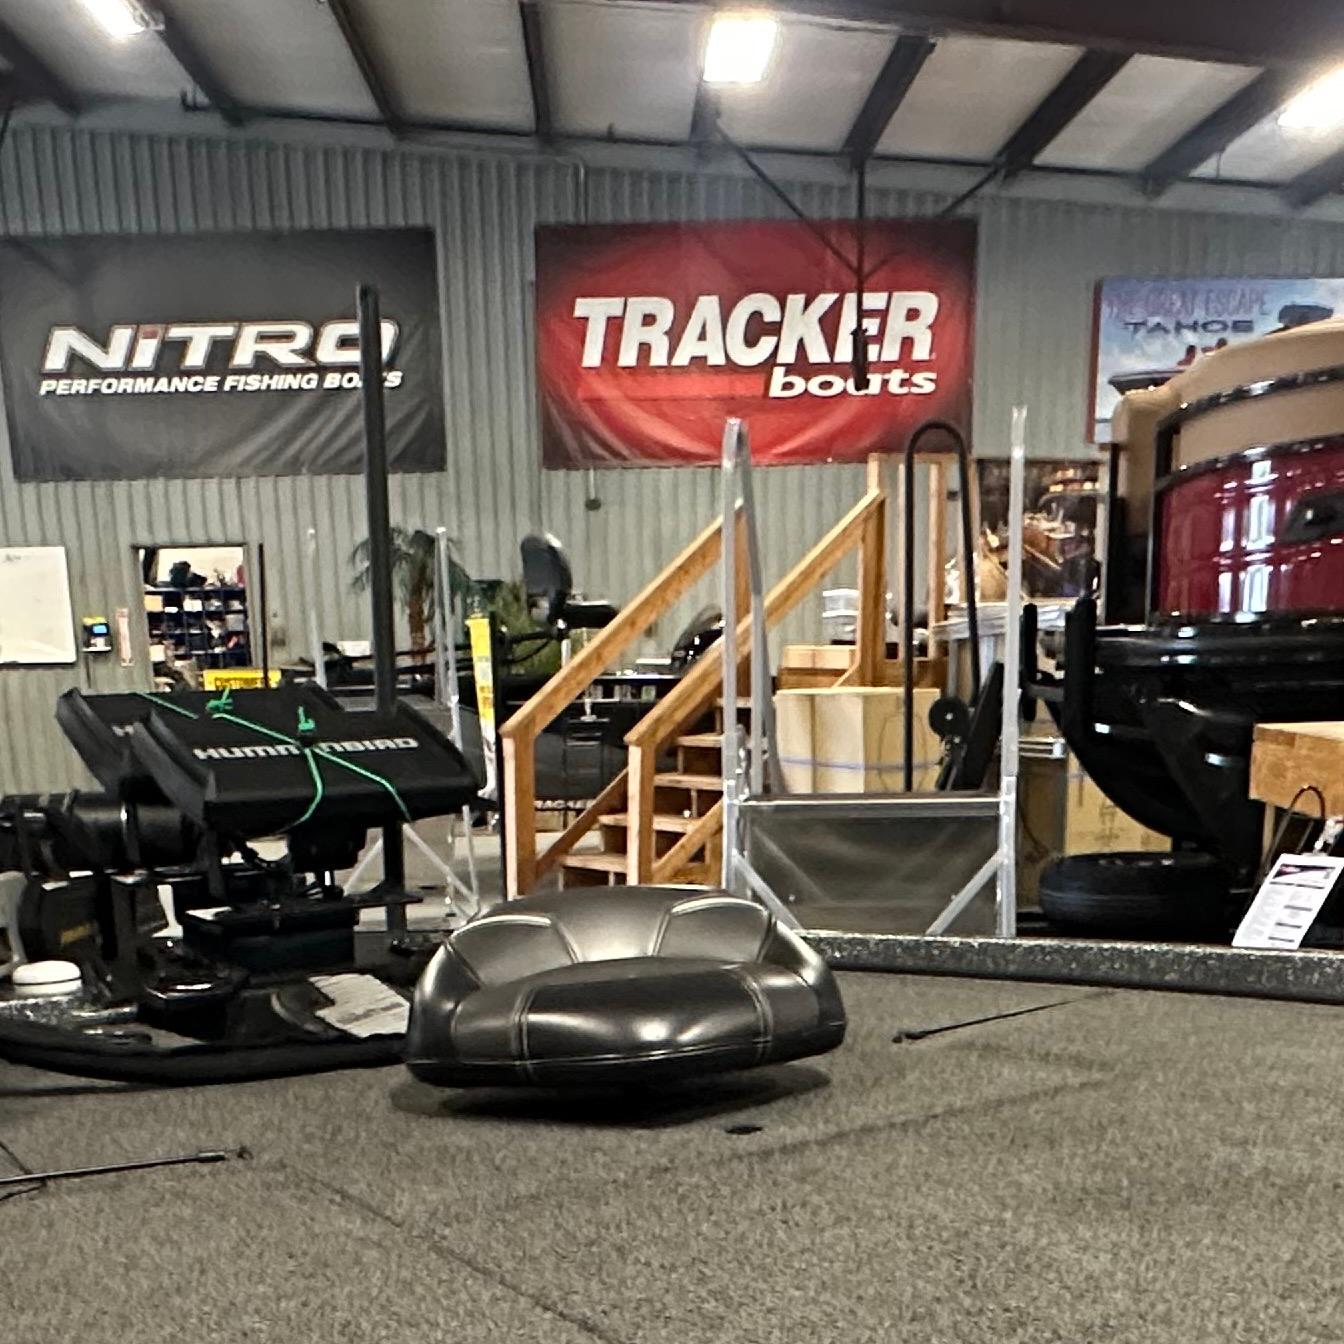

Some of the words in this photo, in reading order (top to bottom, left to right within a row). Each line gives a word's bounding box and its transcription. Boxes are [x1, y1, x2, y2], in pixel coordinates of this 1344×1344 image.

[41, 319, 400, 374] NITRO
[573, 291, 939, 368] TRACKER
[1123, 319, 1255, 336] TAHOE
[39, 376, 220, 396] PERFORMANCE
[223, 374, 318, 392] FISHING
[323, 370, 404, 389] BOS
